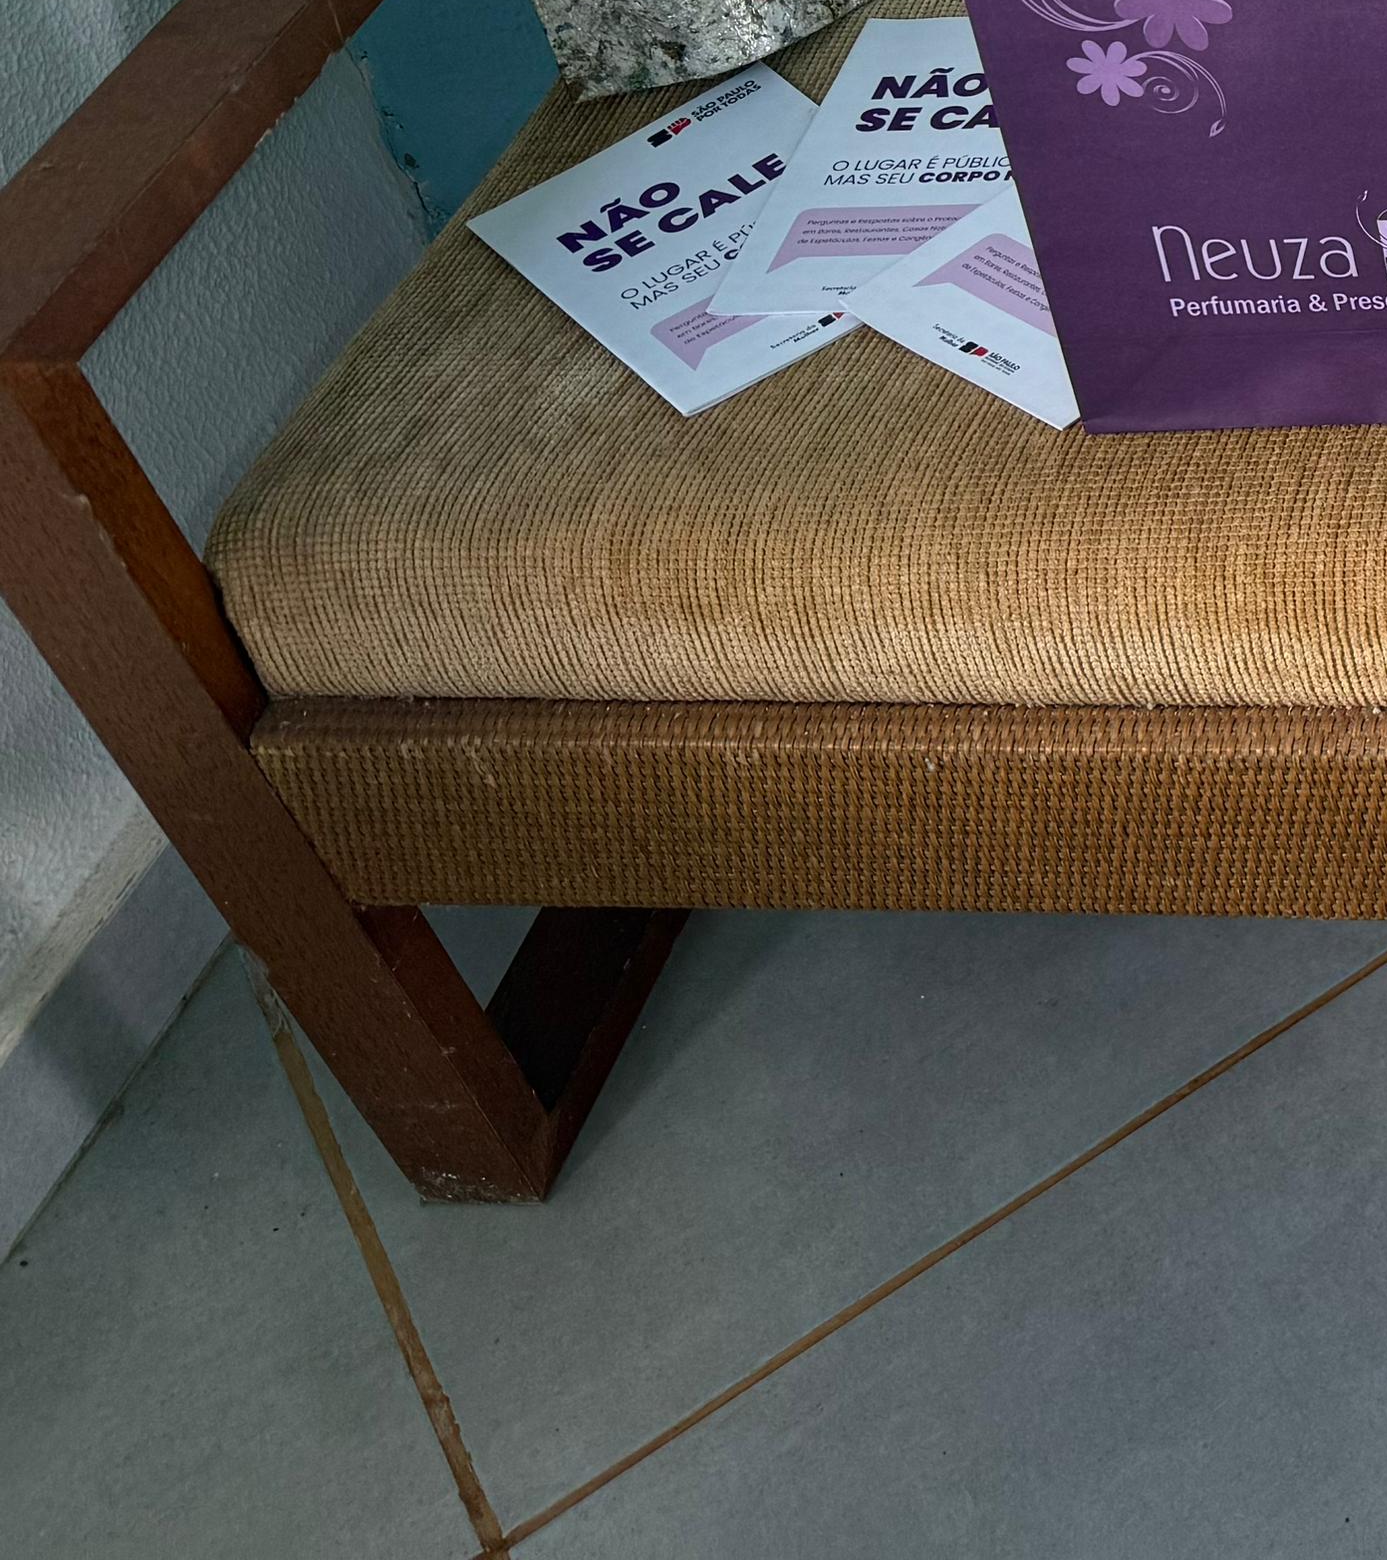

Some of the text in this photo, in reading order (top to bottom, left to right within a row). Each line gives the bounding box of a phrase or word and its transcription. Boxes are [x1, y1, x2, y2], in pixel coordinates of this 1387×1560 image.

[691, 80, 755, 117] SÃO PAULO
[871, 67, 988, 99] NÃO
[696, 84, 761, 122] POR TODAS
[855, 107, 923, 132] SE
[824, 174, 871, 185] MAS
[875, 172, 915, 184] SEU
[919, 170, 1001, 183] CORPO
[832, 160, 849, 171] O
[854, 159, 922, 171] LUGAR
[926, 156, 939, 169] É
[556, 182, 680, 253] NÃO
[583, 230, 655, 272] SE
[621, 288, 639, 299] O
[642, 250, 711, 289] LUGAR
[712, 240, 728, 252] É
[630, 259, 721, 310] MAS SEU
[1169, 295, 1301, 317] Perfumaria
[1308, 294, 1328, 313] &
